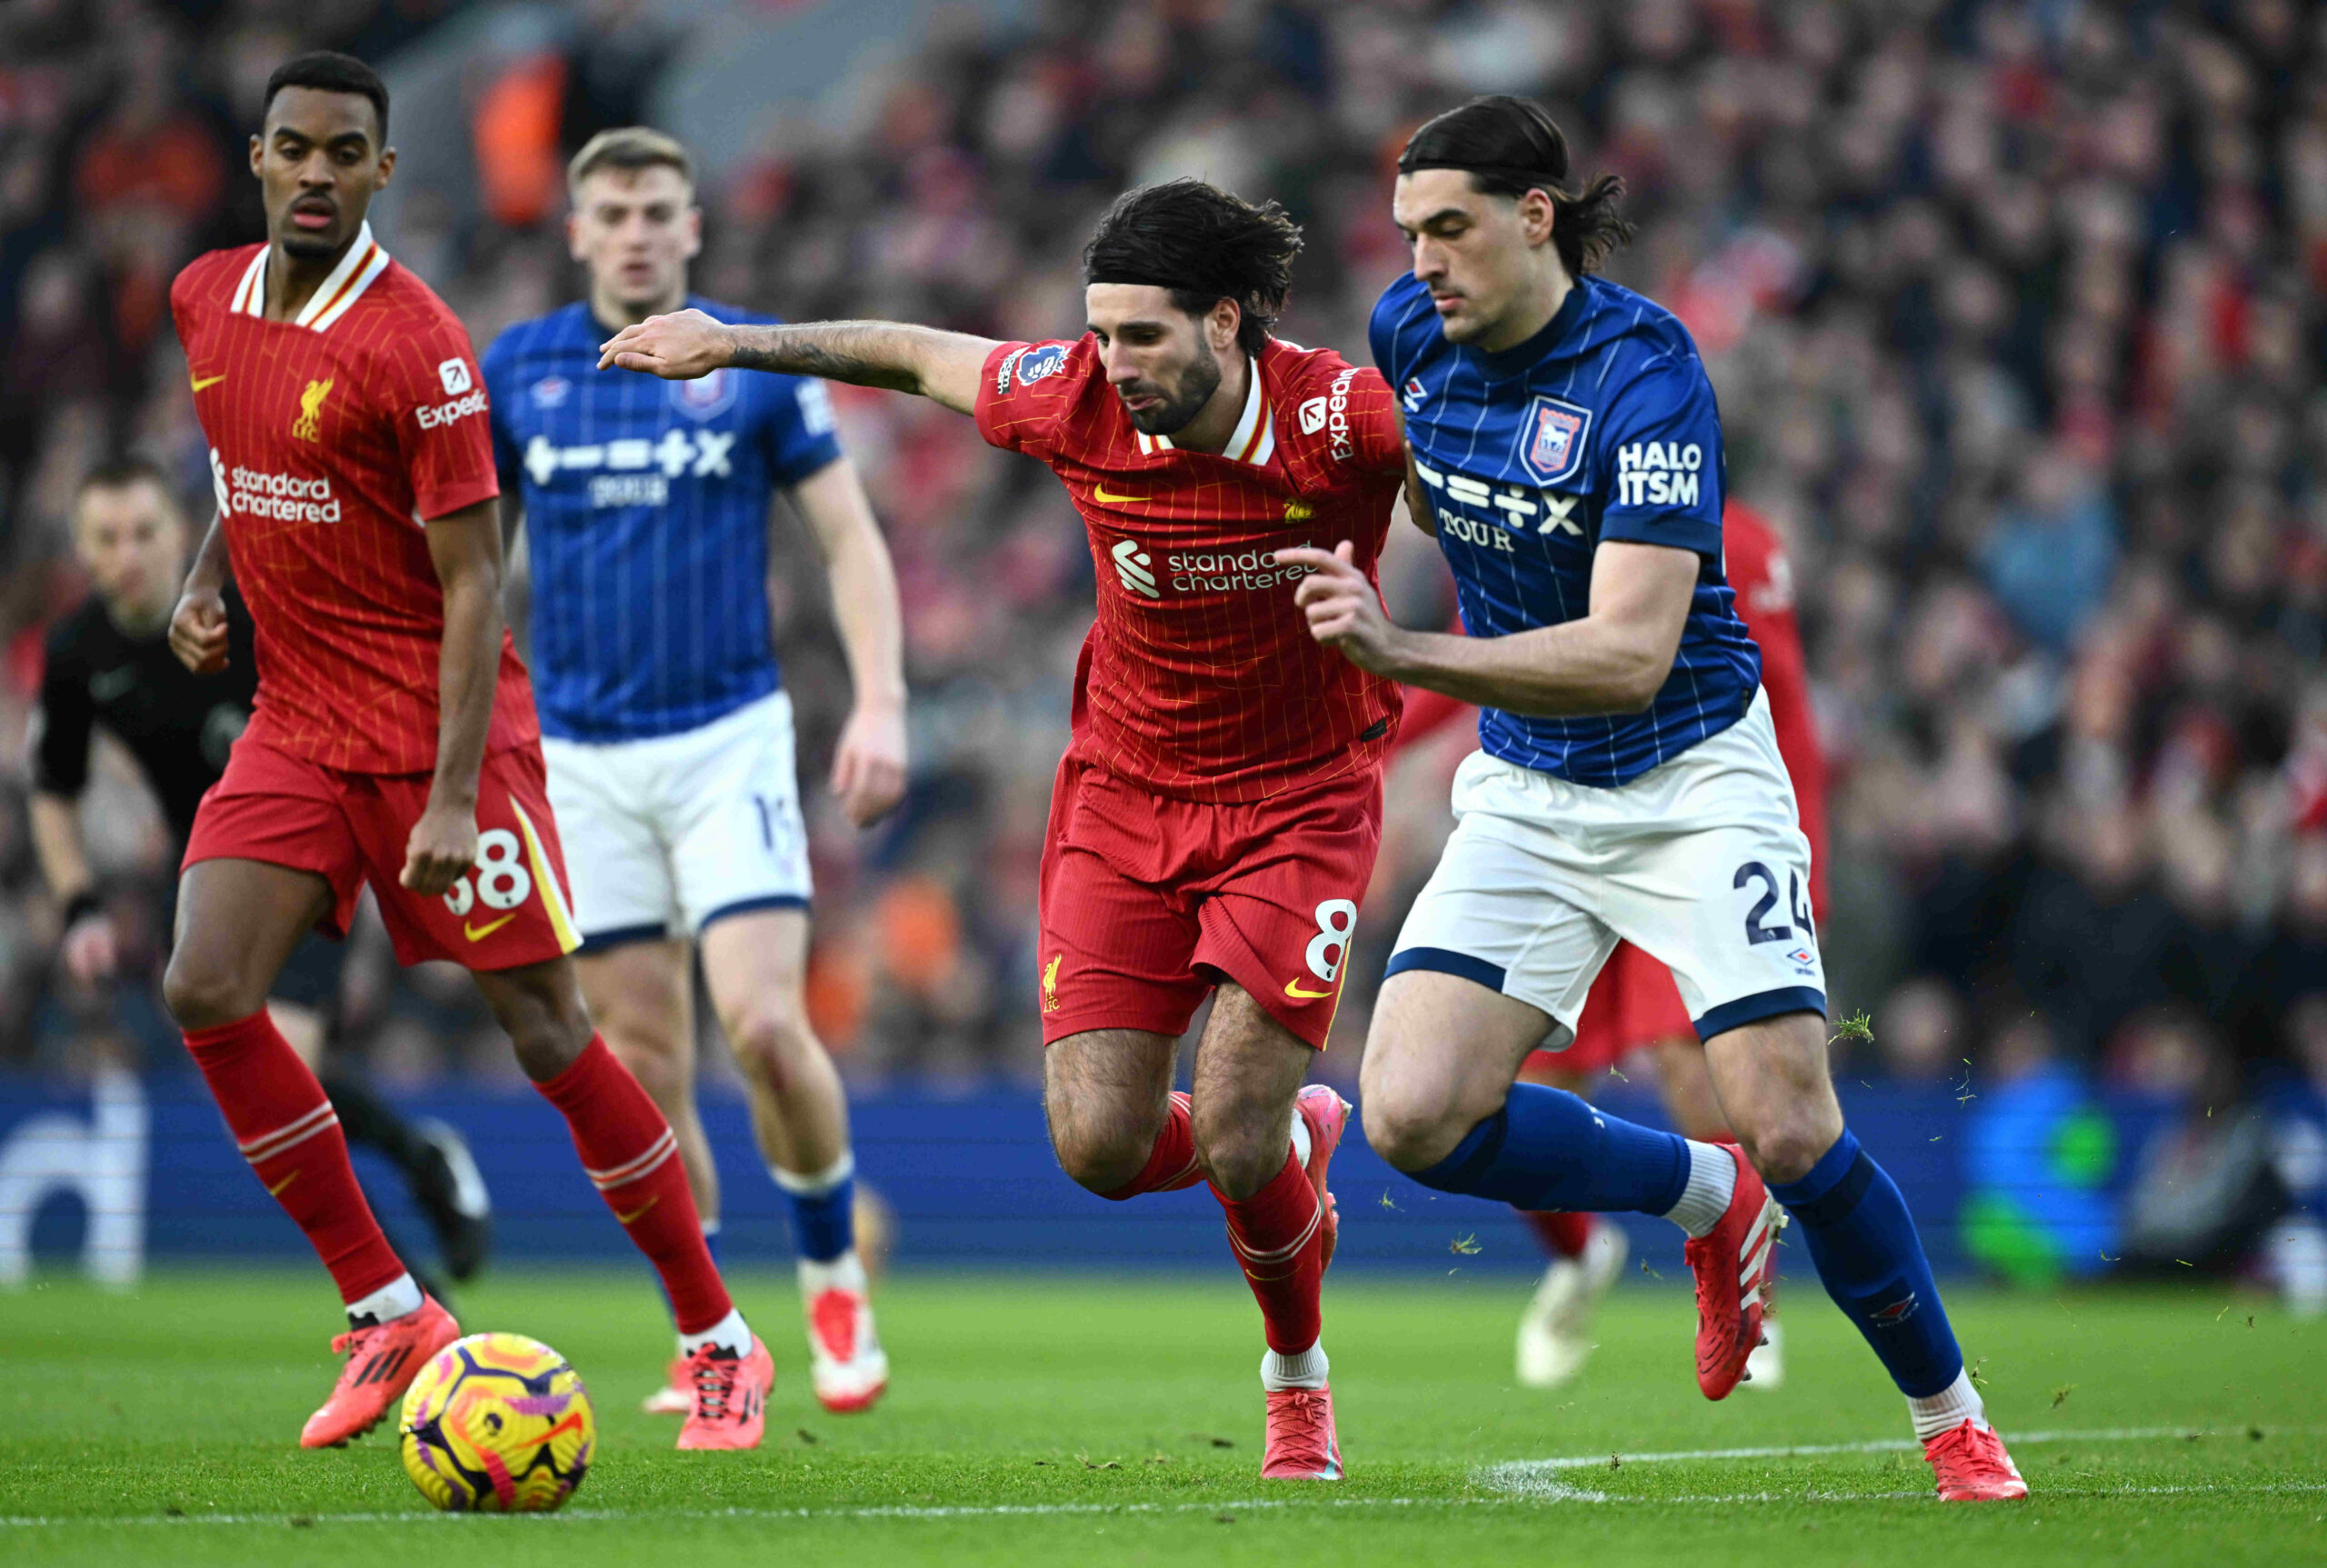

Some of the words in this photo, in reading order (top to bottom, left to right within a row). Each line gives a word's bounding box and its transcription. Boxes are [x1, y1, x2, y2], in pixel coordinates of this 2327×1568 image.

[1618, 441, 1702, 472] HALO
[232, 464, 331, 500] standard
[1618, 470, 1699, 507] ITSM
[232, 492, 341, 523] chartered
[1438, 506, 1515, 553] TOUR
[1167, 539, 1312, 572] standa
[1733, 861, 1814, 946] 24
[1305, 898, 1358, 983] 8
[1044, 999, 1061, 1014] LFC
